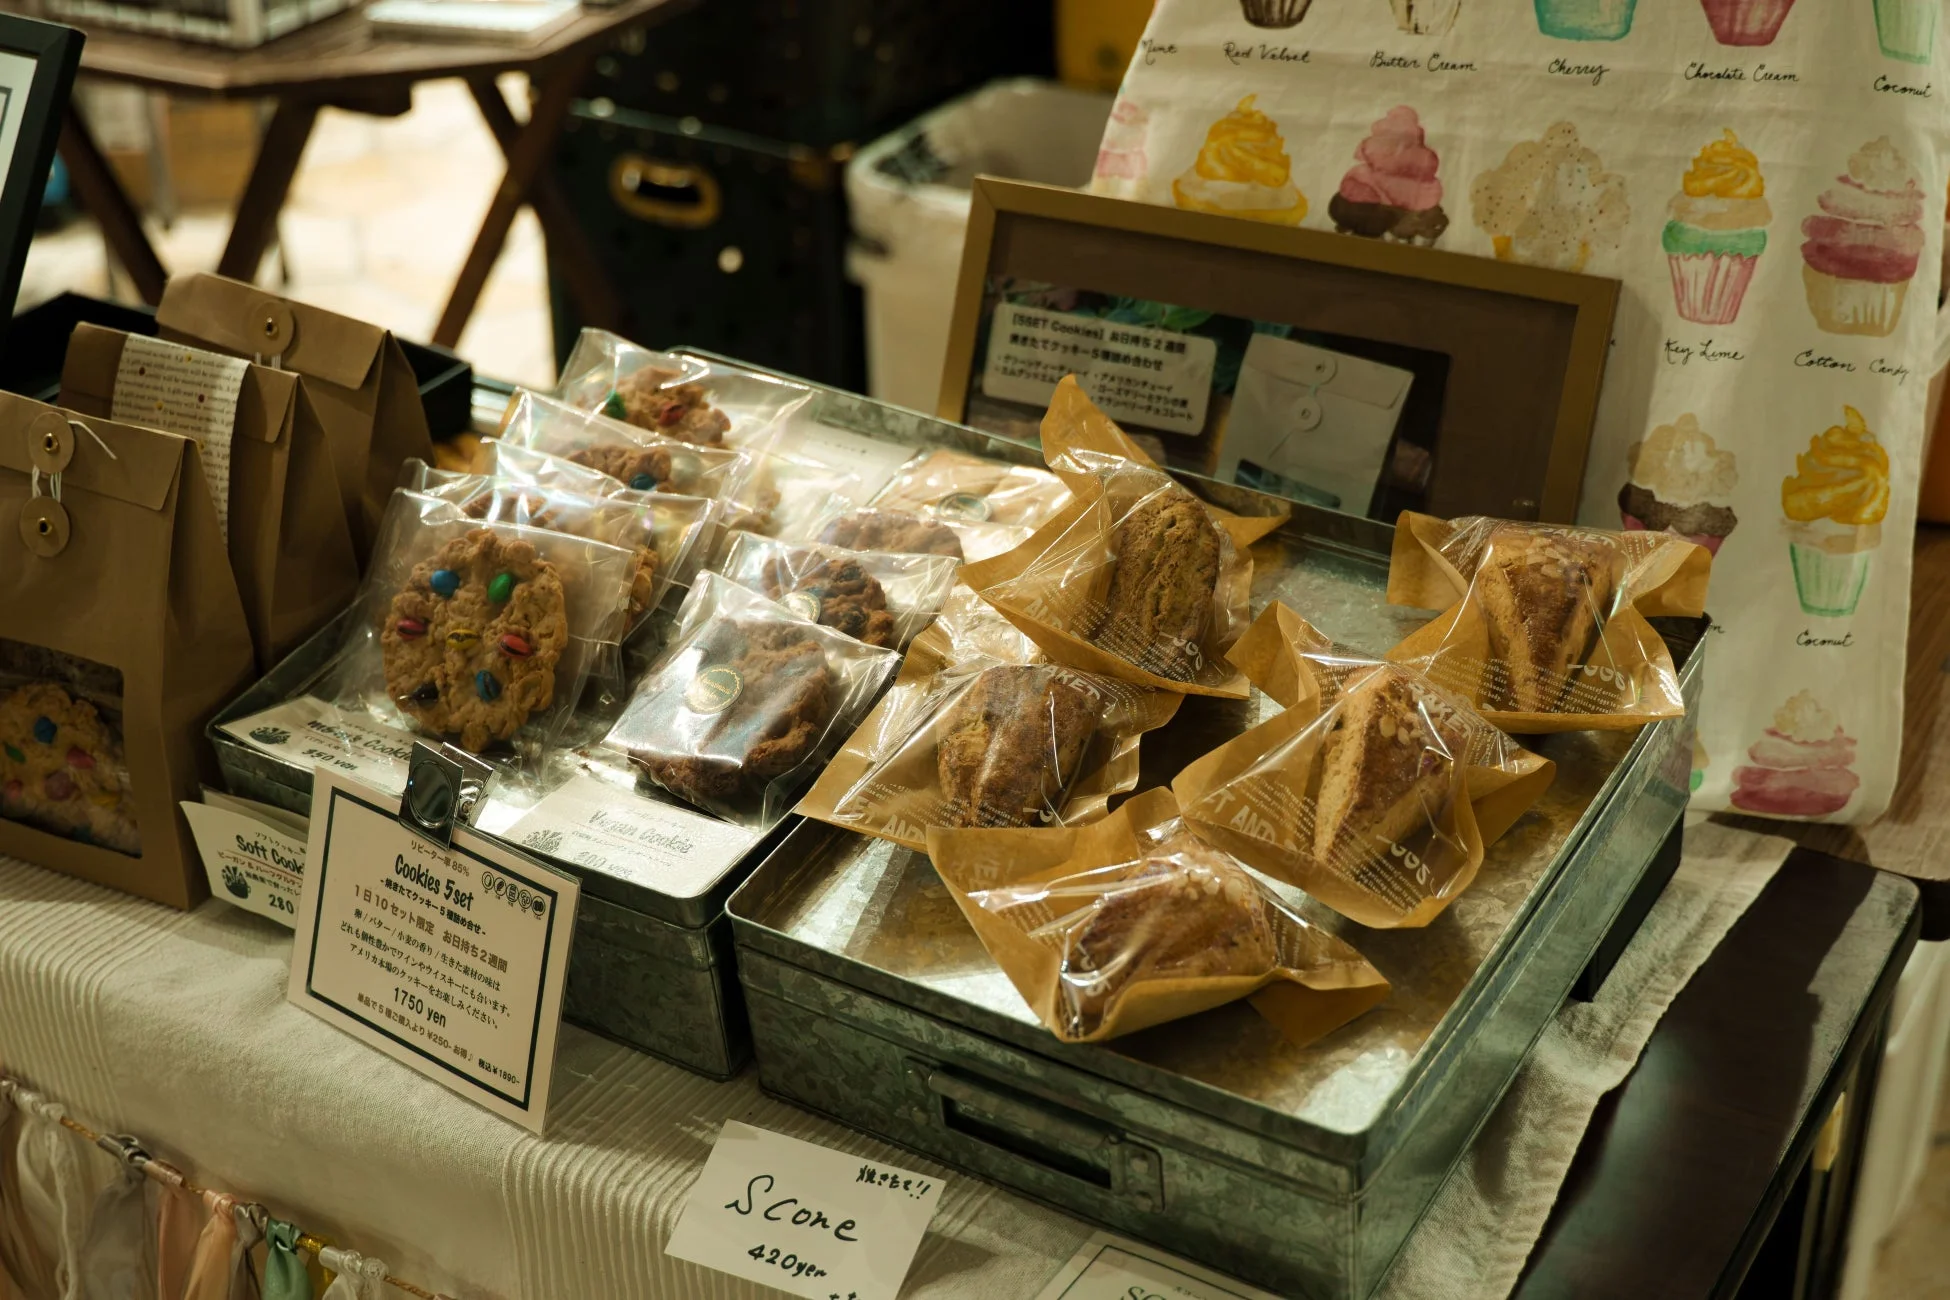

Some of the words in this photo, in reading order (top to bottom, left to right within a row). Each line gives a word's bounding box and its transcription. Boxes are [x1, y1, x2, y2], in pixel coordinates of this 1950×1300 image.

[1223, 42, 1251, 65] Red
[1260, 44, 1311, 64] Velvet
[1370, 50, 1421, 68] Butter
[1427, 52, 1478, 72] Cream
[1548, 58, 1610, 86] Cherry
[1684, 62, 1746, 81] Chocolate
[1753, 64, 1800, 82] Cream
[1874, 75, 1932, 98] Coconut
[1664, 337, 1694, 365] Key
[1700, 339, 1745, 362] Lime
[1795, 349, 1856, 372] Cotton
[1868, 359, 1911, 385] Candy
[1795, 629, 1854, 648] Coconut
[236, 834, 268, 861] Soft
[394, 853, 441, 896] Cookies
[443, 878, 475, 912] 5set
[268, 893, 295, 915] 280
[393, 986, 425, 1015] 1750
[427, 1006, 448, 1028] yen
[724, 1174, 858, 1242] Scone
